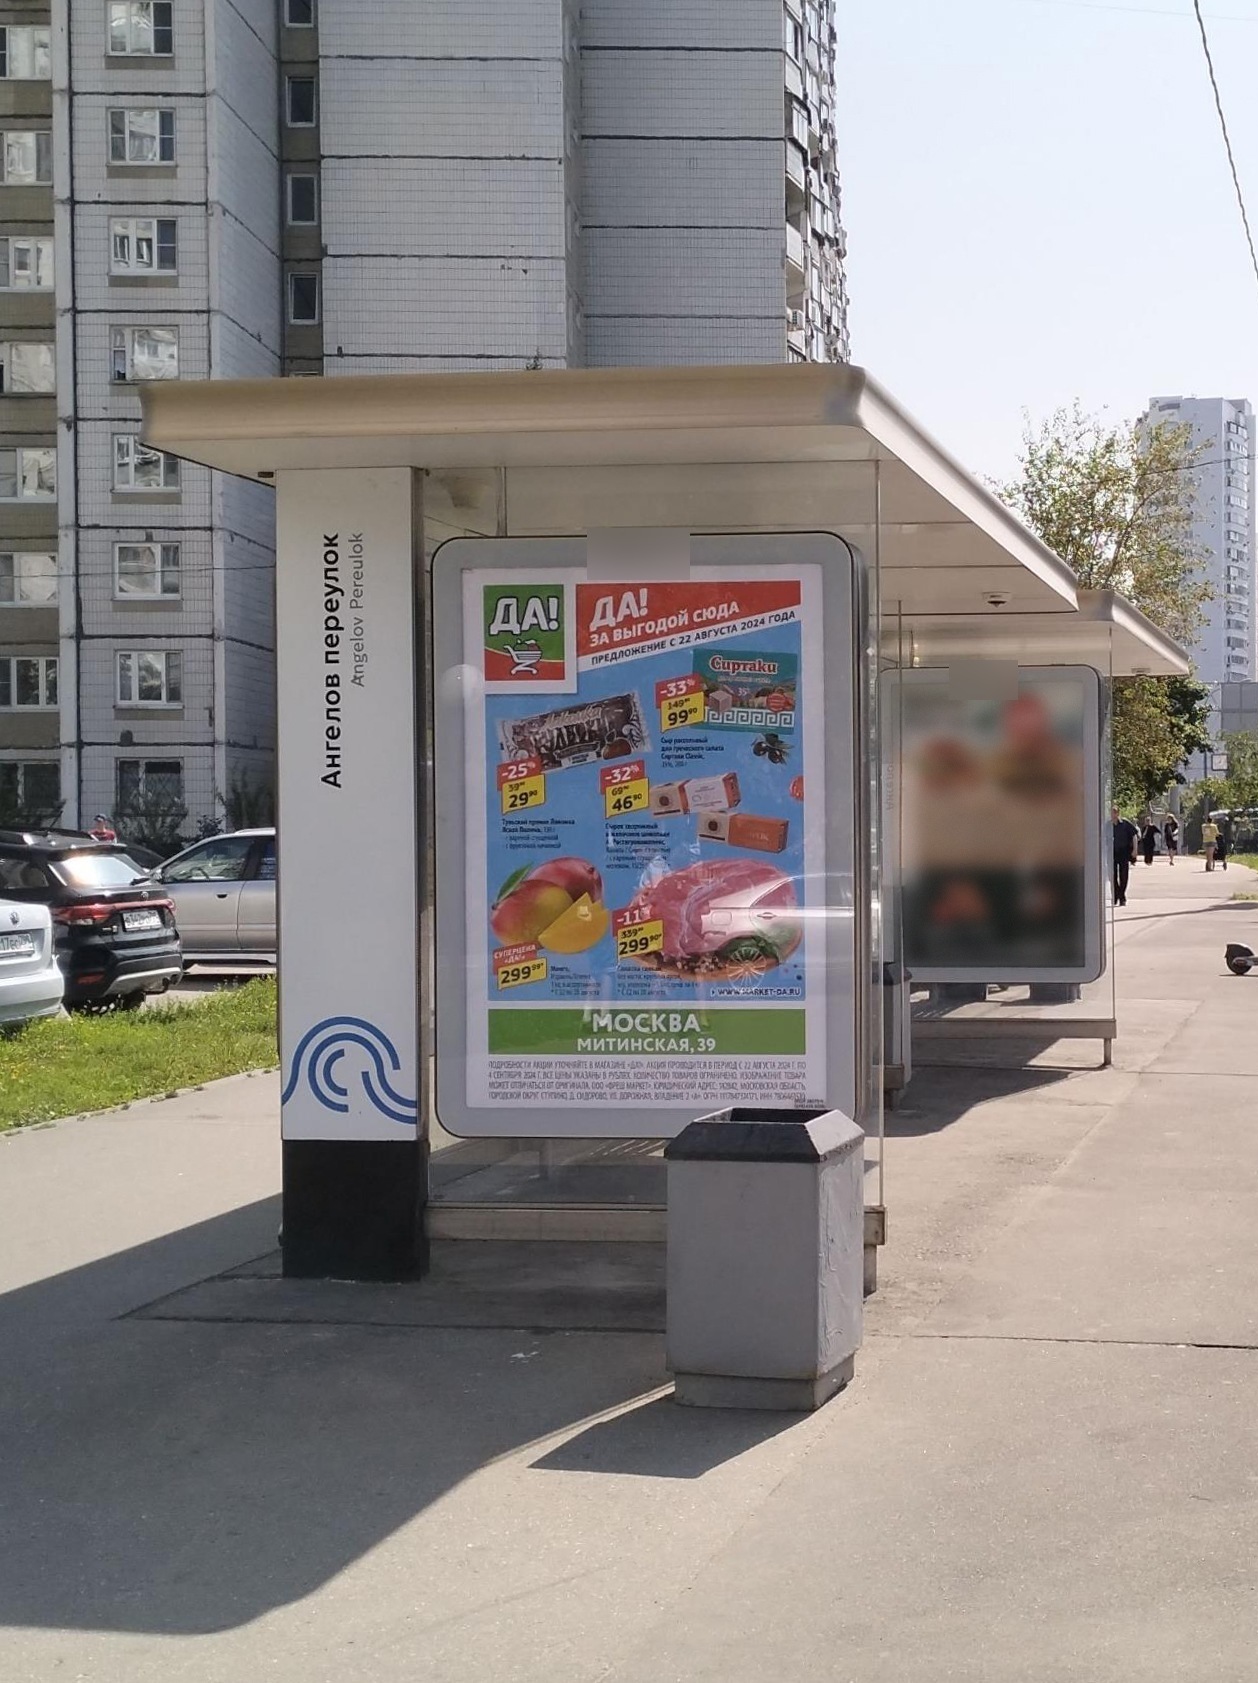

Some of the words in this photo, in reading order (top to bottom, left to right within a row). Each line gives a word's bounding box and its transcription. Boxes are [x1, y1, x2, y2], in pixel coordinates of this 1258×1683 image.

[347, 532, 364, 609] Pereulok
[323, 532, 345, 664] переулок
[488, 596, 560, 637] ДА!
[589, 587, 648, 631] ДА!
[589, 633, 610, 647] ЗА
[612, 608, 688, 642] ВЫГОДОЙ
[693, 601, 740, 622] СЮДА
[591, 640, 667, 666] ПРЕДЛОЖЕНИЕ
[669, 638, 676, 647] С
[678, 635, 692, 645] 22
[694, 625, 738, 642] АВГУСТА
[740, 618, 766, 631] 2024
[768, 610, 796, 624] ГОДА
[348, 616, 368, 687] Angelov
[709, 655, 778, 674] Сиртаки
[320, 673, 342, 788] Ангелов
[577, 1038, 695, 1053] МИТИНСКАЯ,
[697, 1038, 716, 1052] 39
[592, 1013, 701, 1033] МОСКВА
